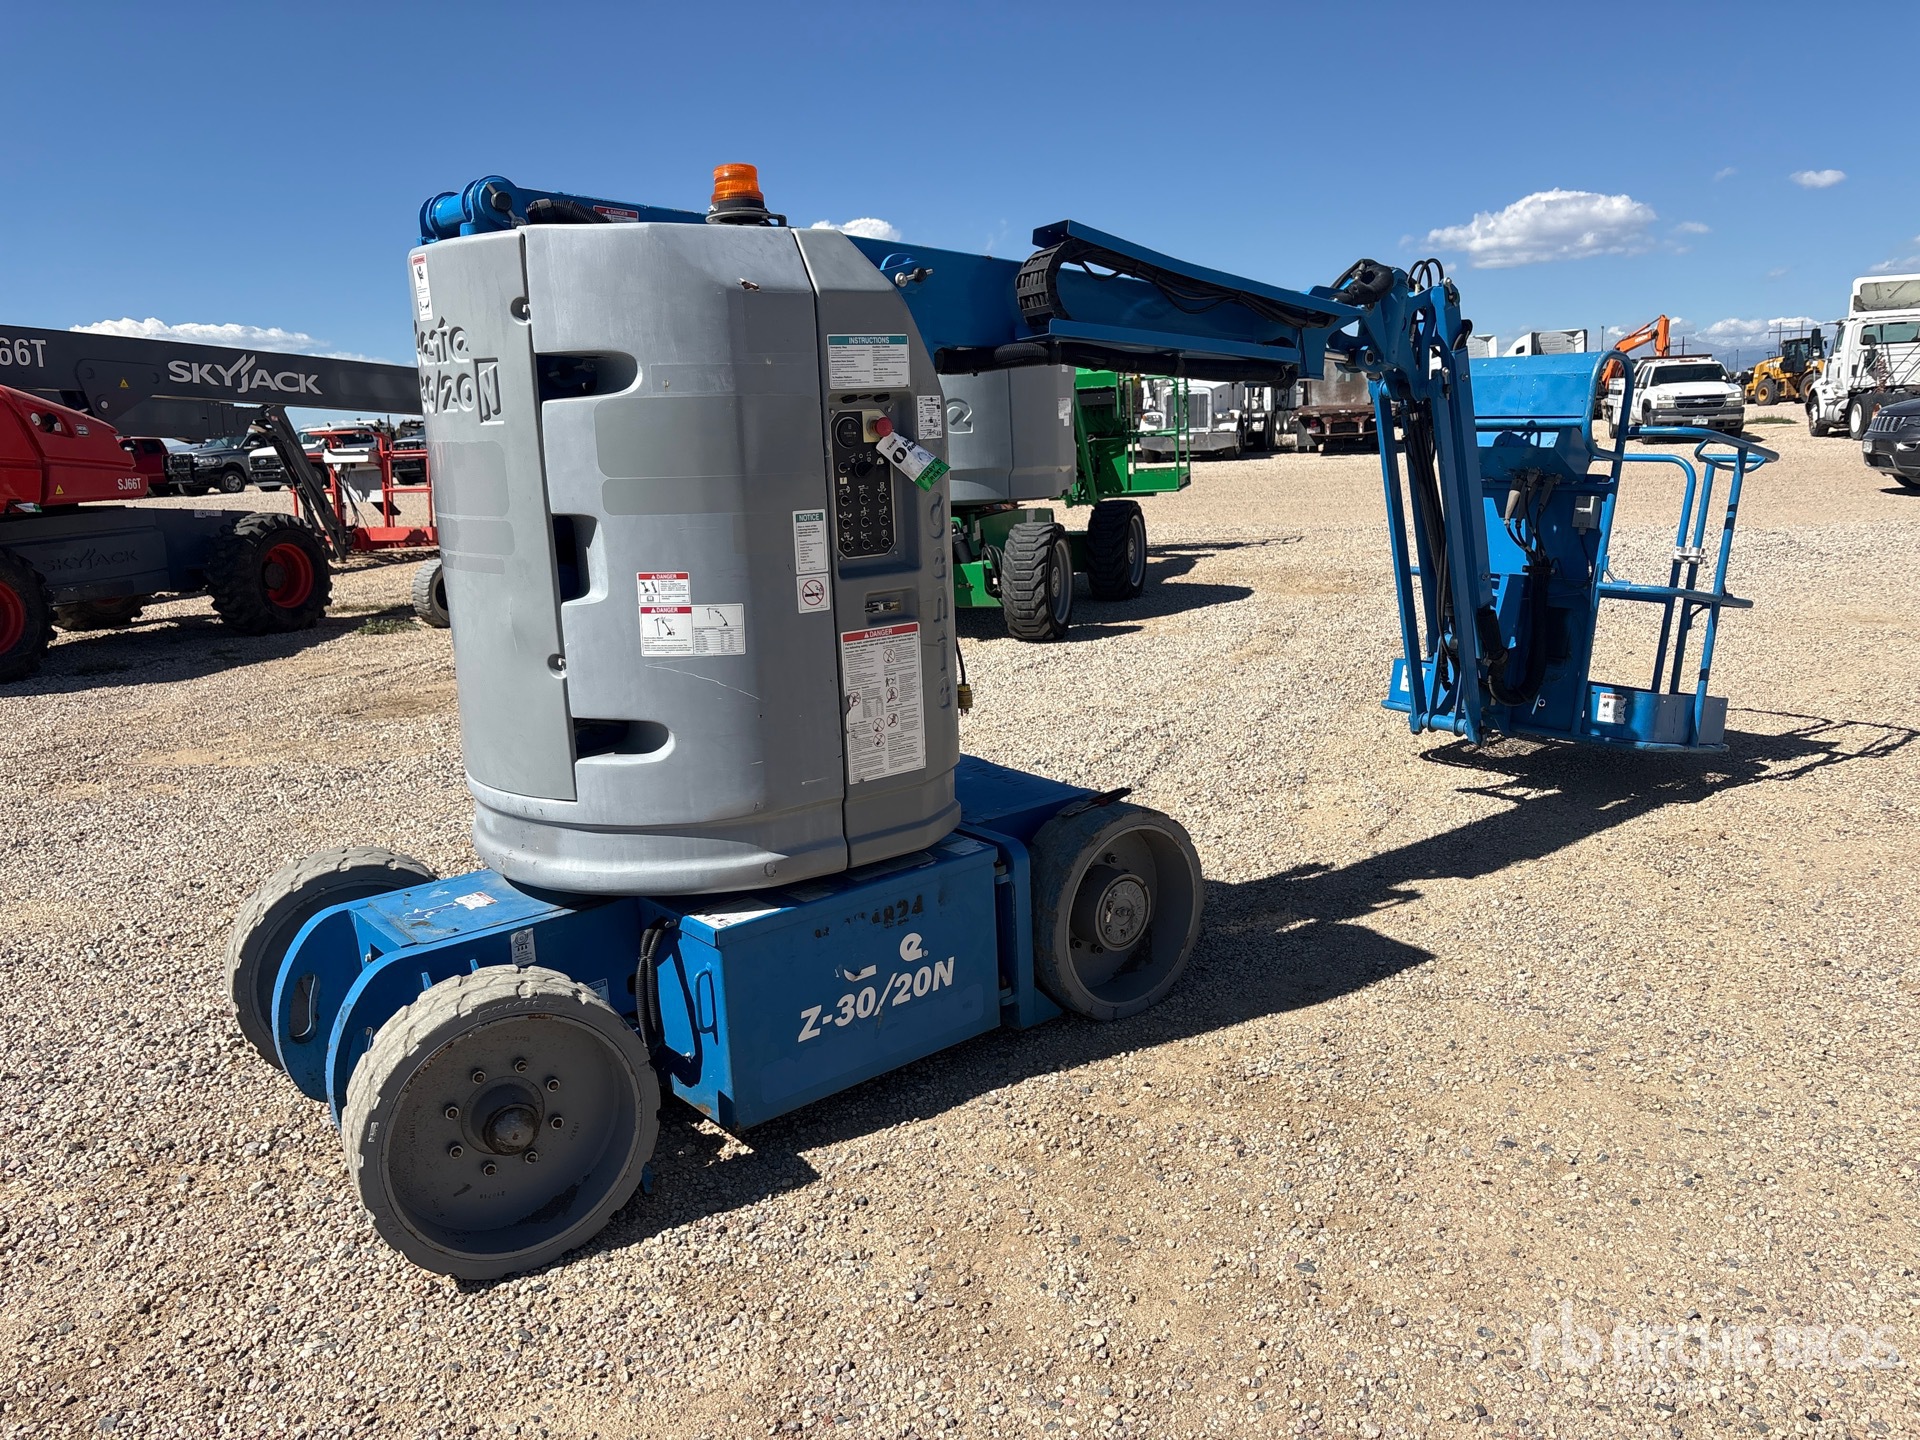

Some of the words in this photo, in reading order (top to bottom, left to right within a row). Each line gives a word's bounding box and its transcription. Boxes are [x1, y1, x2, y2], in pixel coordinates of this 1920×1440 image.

[848, 336, 890, 344] INSTRUCTIONS
[167, 353, 323, 395] SKYJACK
[921, 464, 936, 481] READY
[929, 467, 943, 481] RENT
[117, 477, 141, 491] SJ66T
[798, 513, 820, 522] NOTICE
[42, 547, 139, 573] SKYJACK
[869, 628, 893, 638] DANGER
[797, 956, 955, 1043] Z-30/20N
